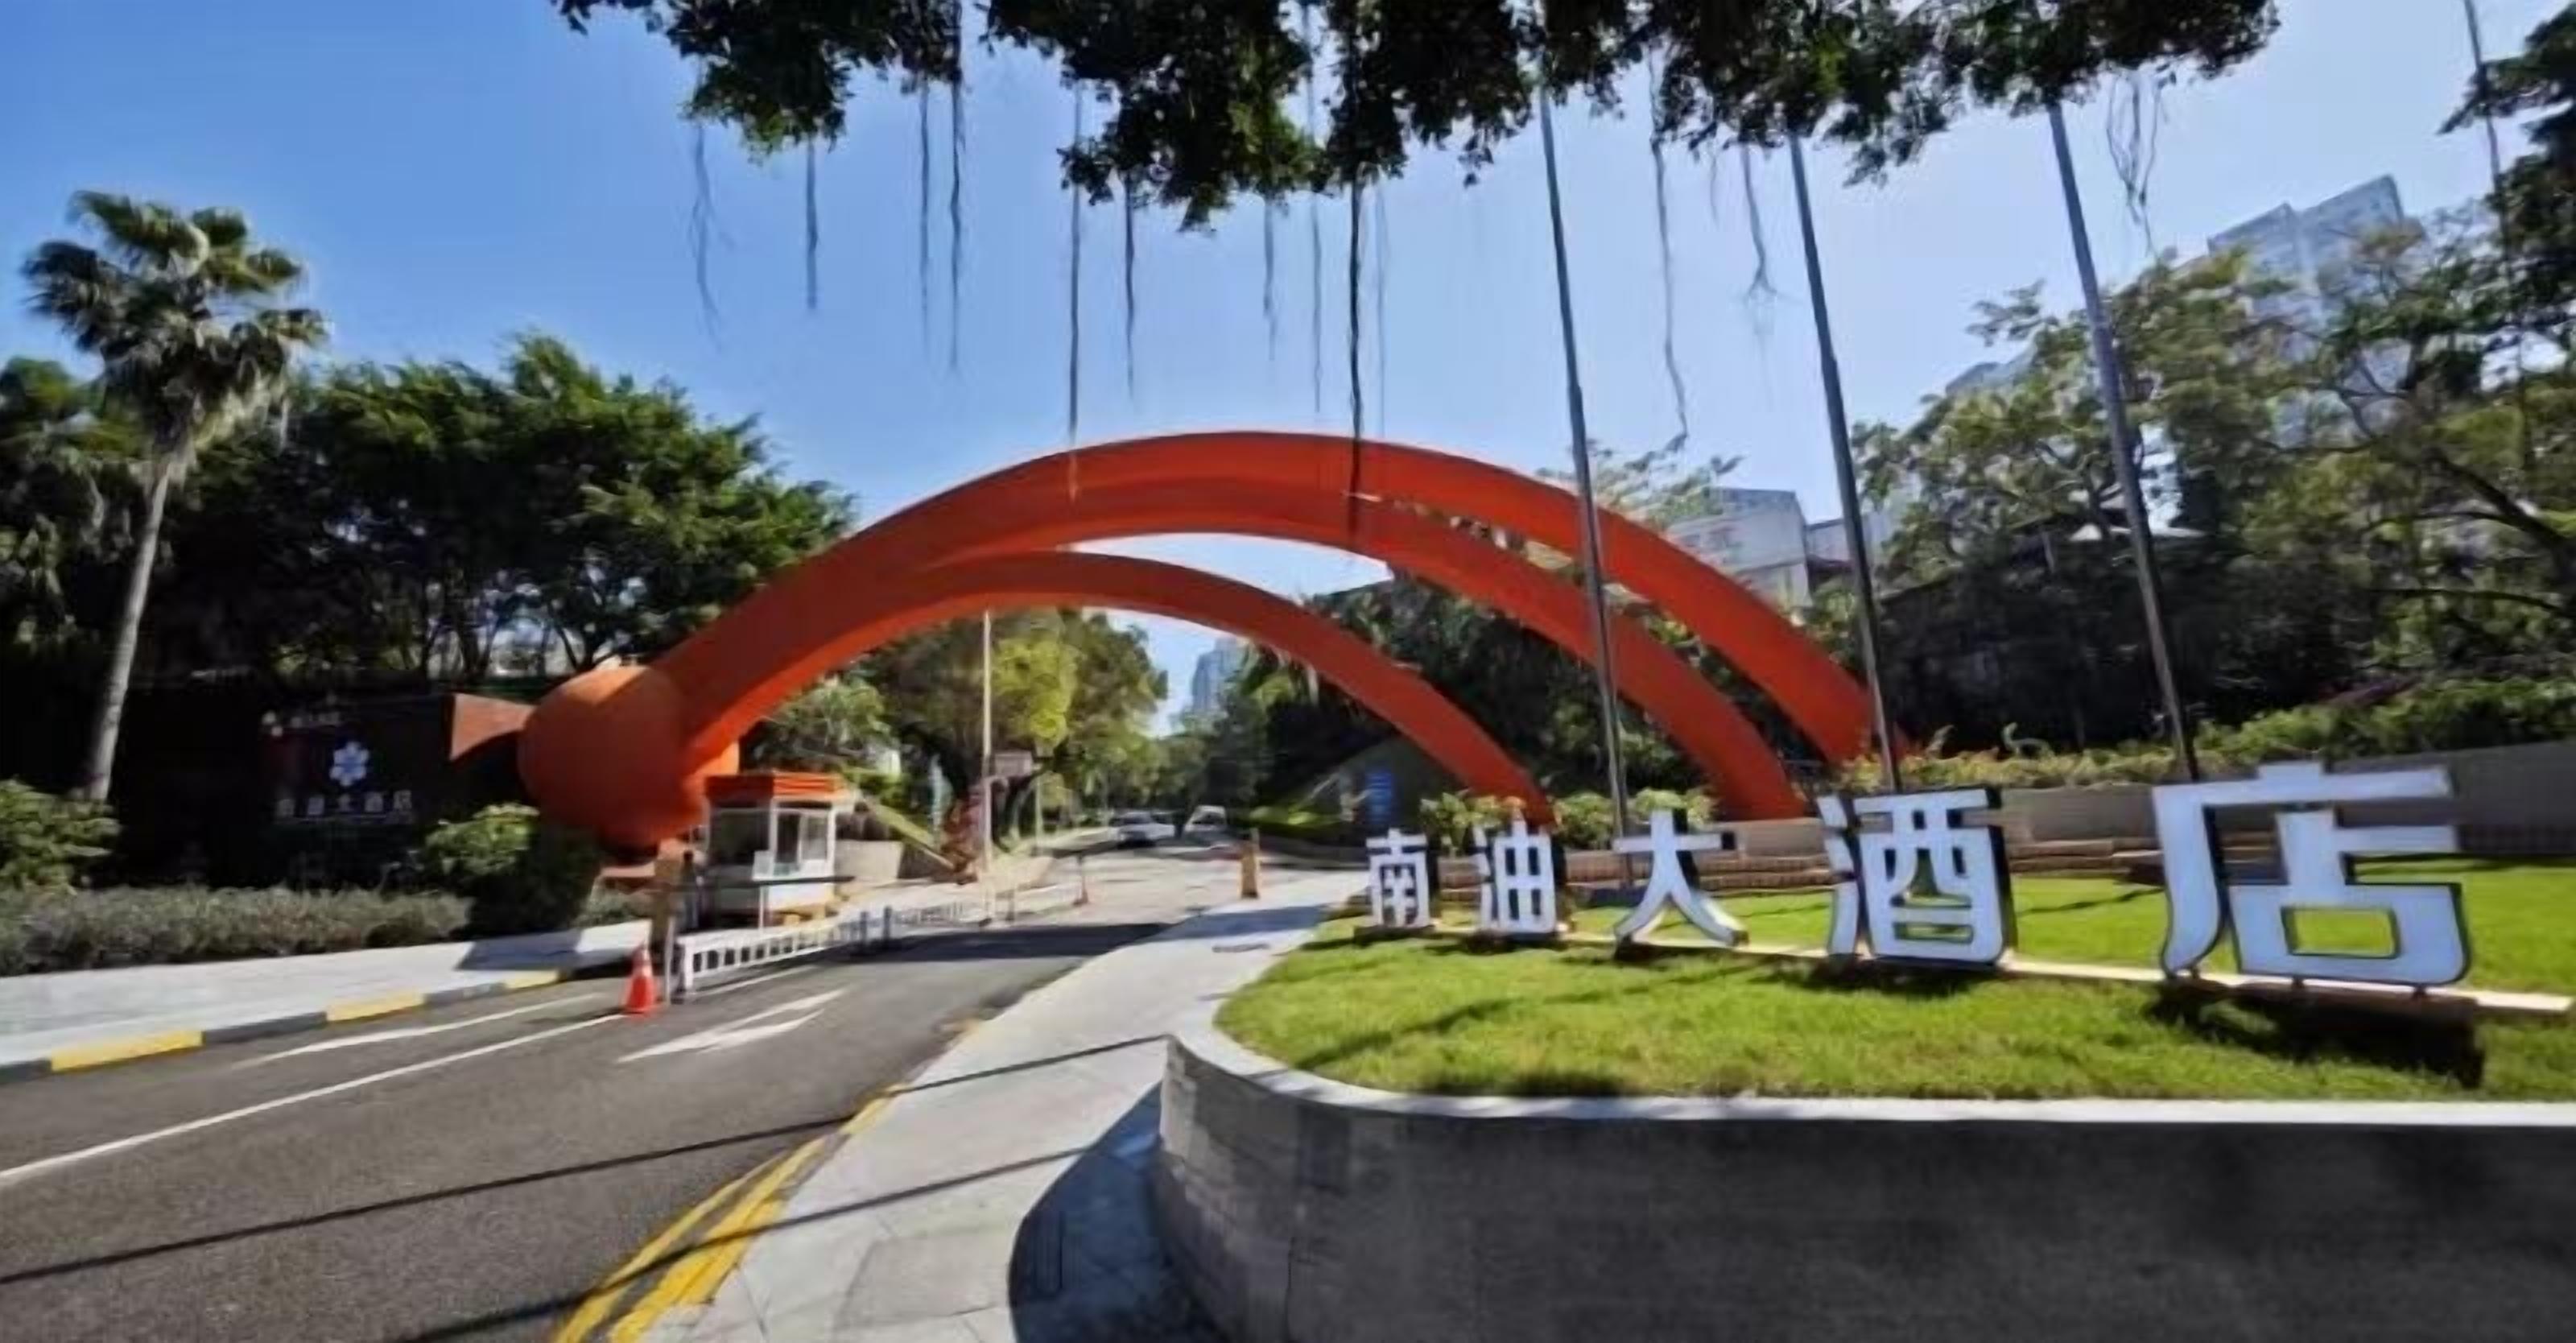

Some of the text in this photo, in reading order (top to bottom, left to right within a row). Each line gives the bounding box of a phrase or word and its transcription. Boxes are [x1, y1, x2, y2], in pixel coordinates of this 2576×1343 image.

[1366, 762, 2471, 985] 南油大酒店
